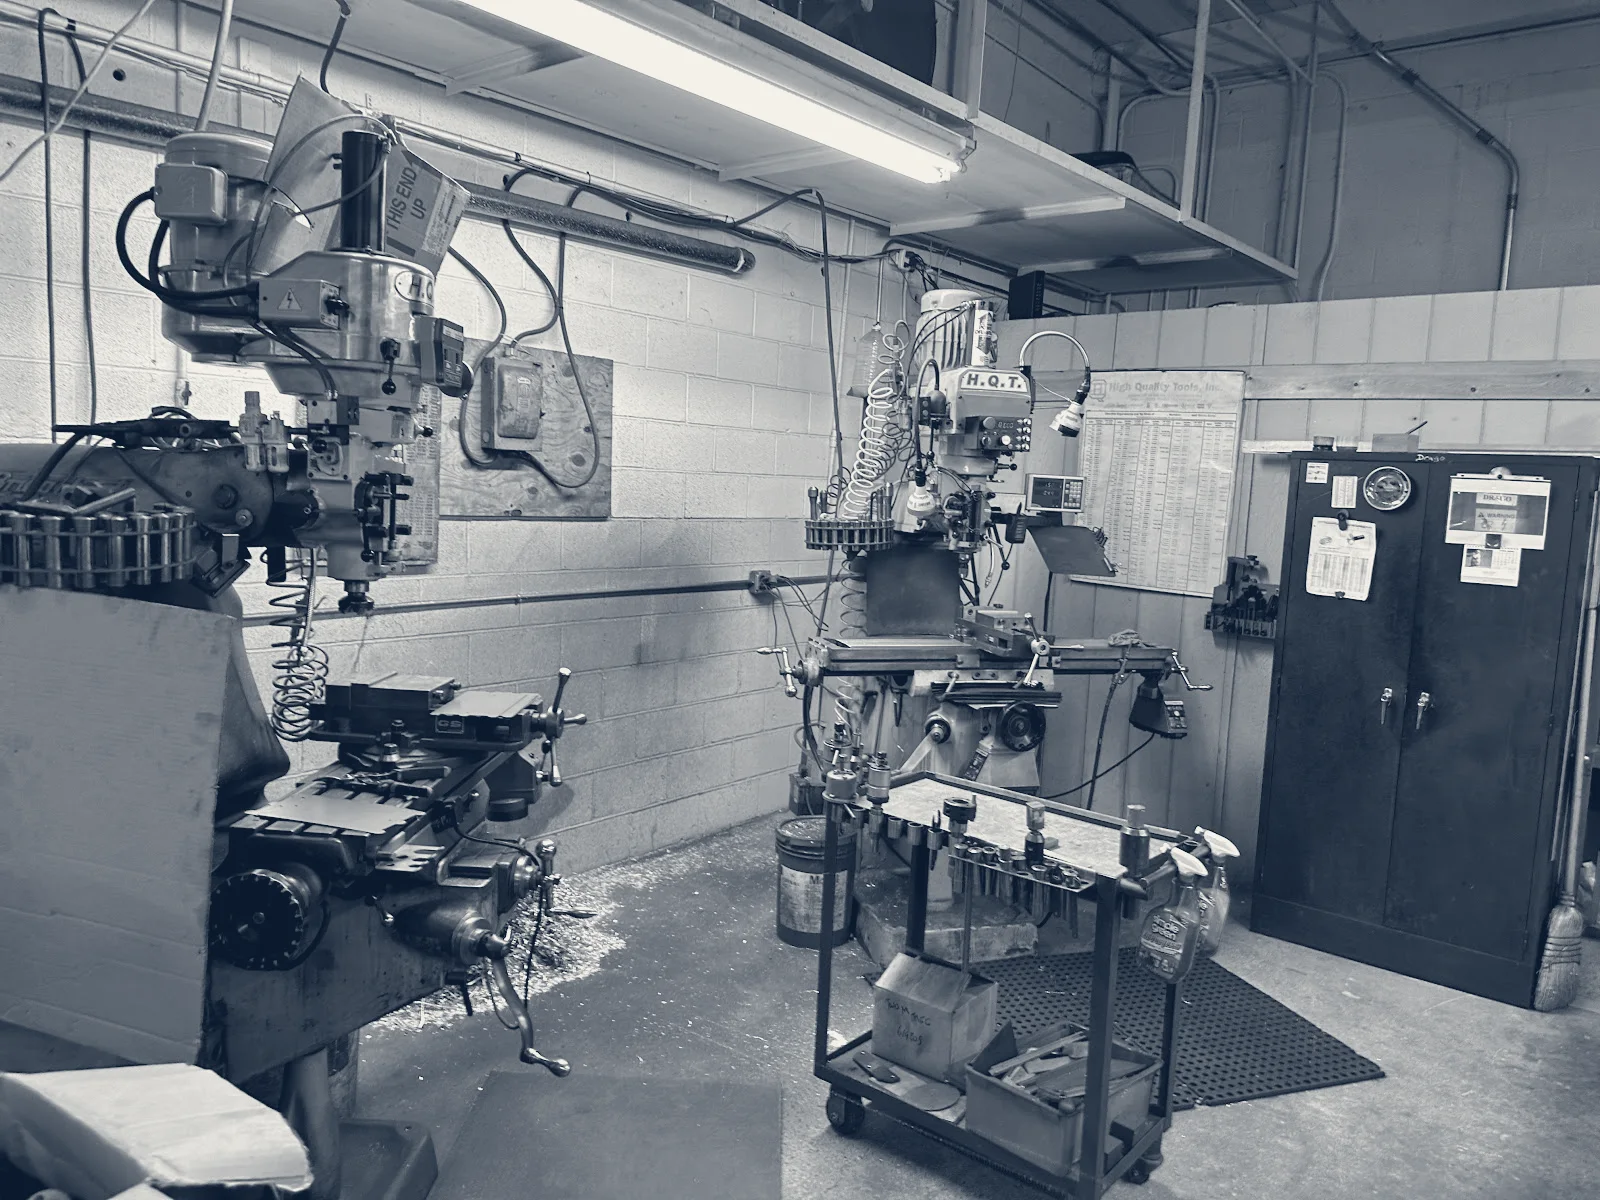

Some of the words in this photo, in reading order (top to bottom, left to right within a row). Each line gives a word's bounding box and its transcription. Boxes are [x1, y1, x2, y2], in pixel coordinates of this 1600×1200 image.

[396, 167, 417, 199] END
[386, 198, 407, 231] THIS
[410, 198, 427, 220] UP
[966, 373, 1021, 388] H.Q.T.
[1109, 382, 1132, 393] High
[1151, 923, 1176, 941] green
